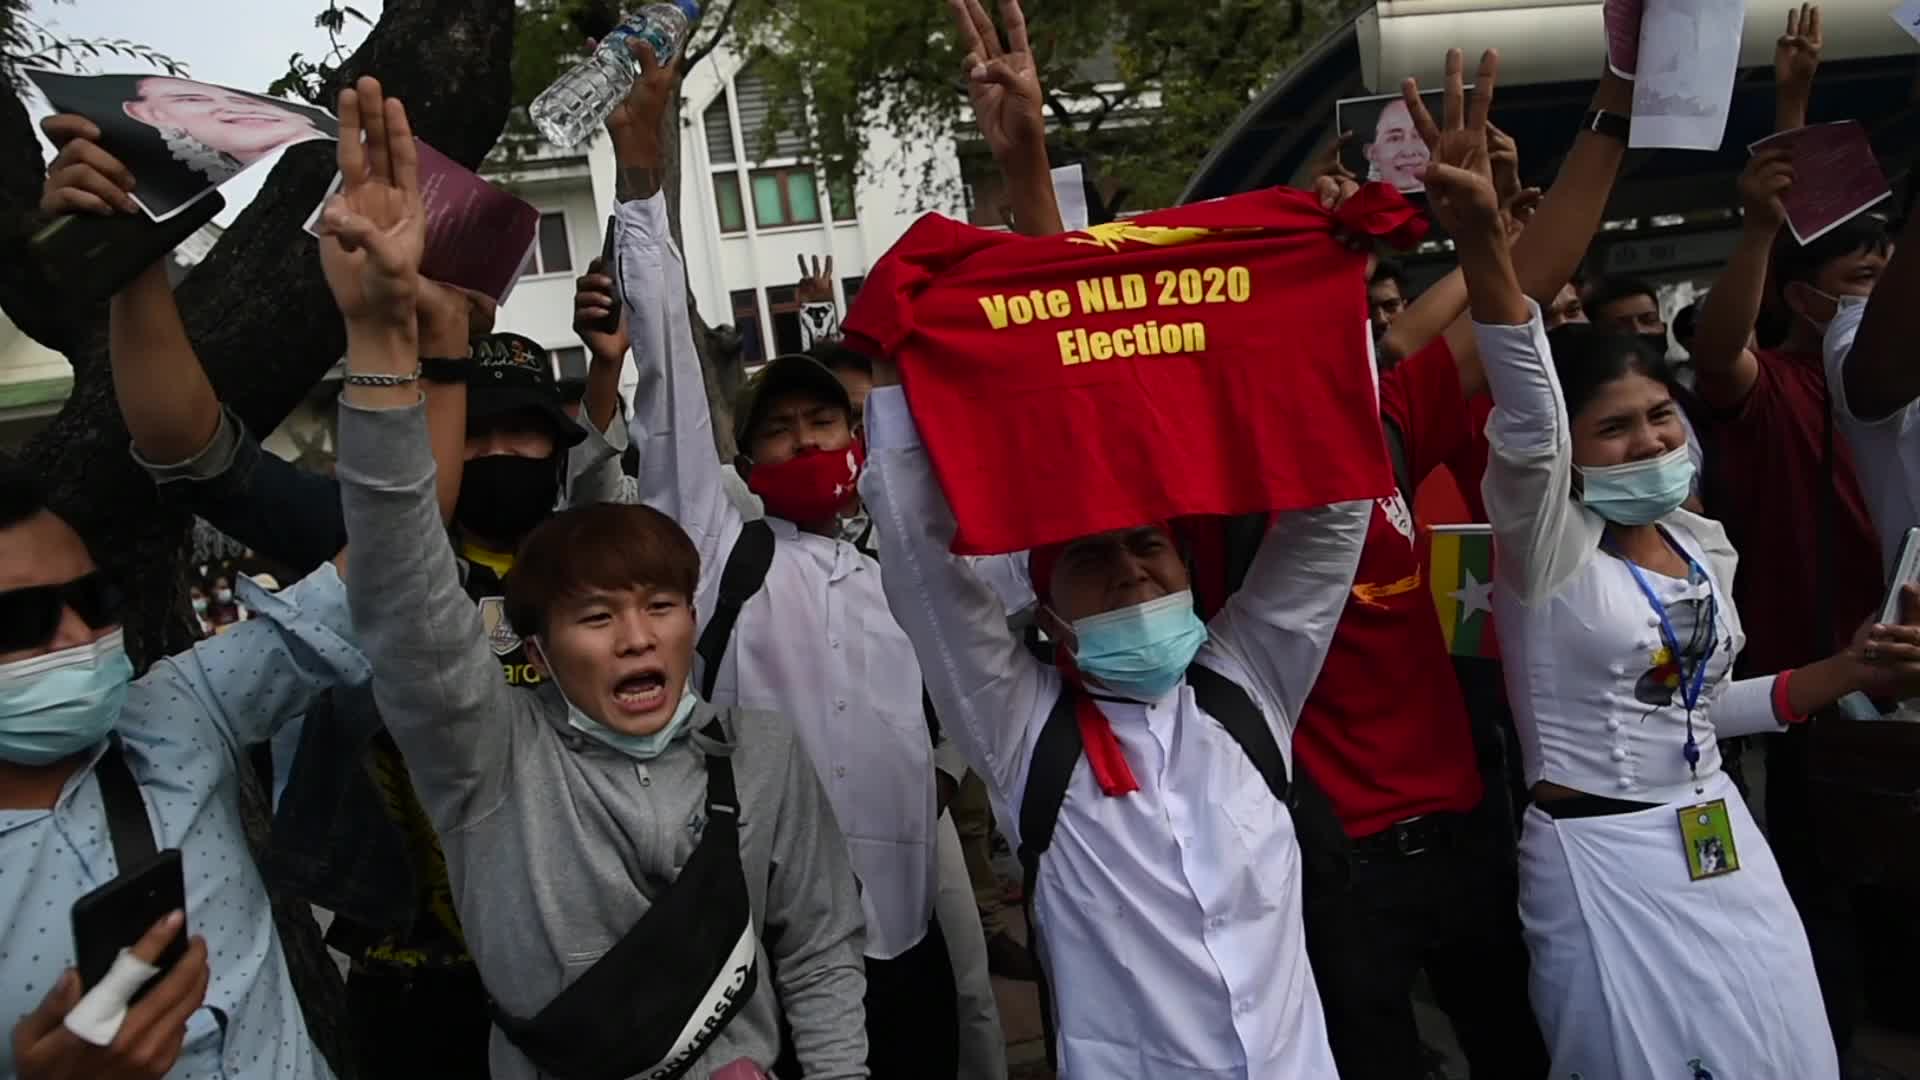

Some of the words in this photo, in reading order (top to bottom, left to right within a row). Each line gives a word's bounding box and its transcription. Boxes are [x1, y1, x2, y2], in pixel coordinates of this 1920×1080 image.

[978, 289, 1072, 330] Vote
[1076, 273, 1148, 314] NLD
[1155, 265, 1250, 306] 2020
[1056, 320, 1206, 366] Election
[642, 985, 736, 1080] ONVERSE
